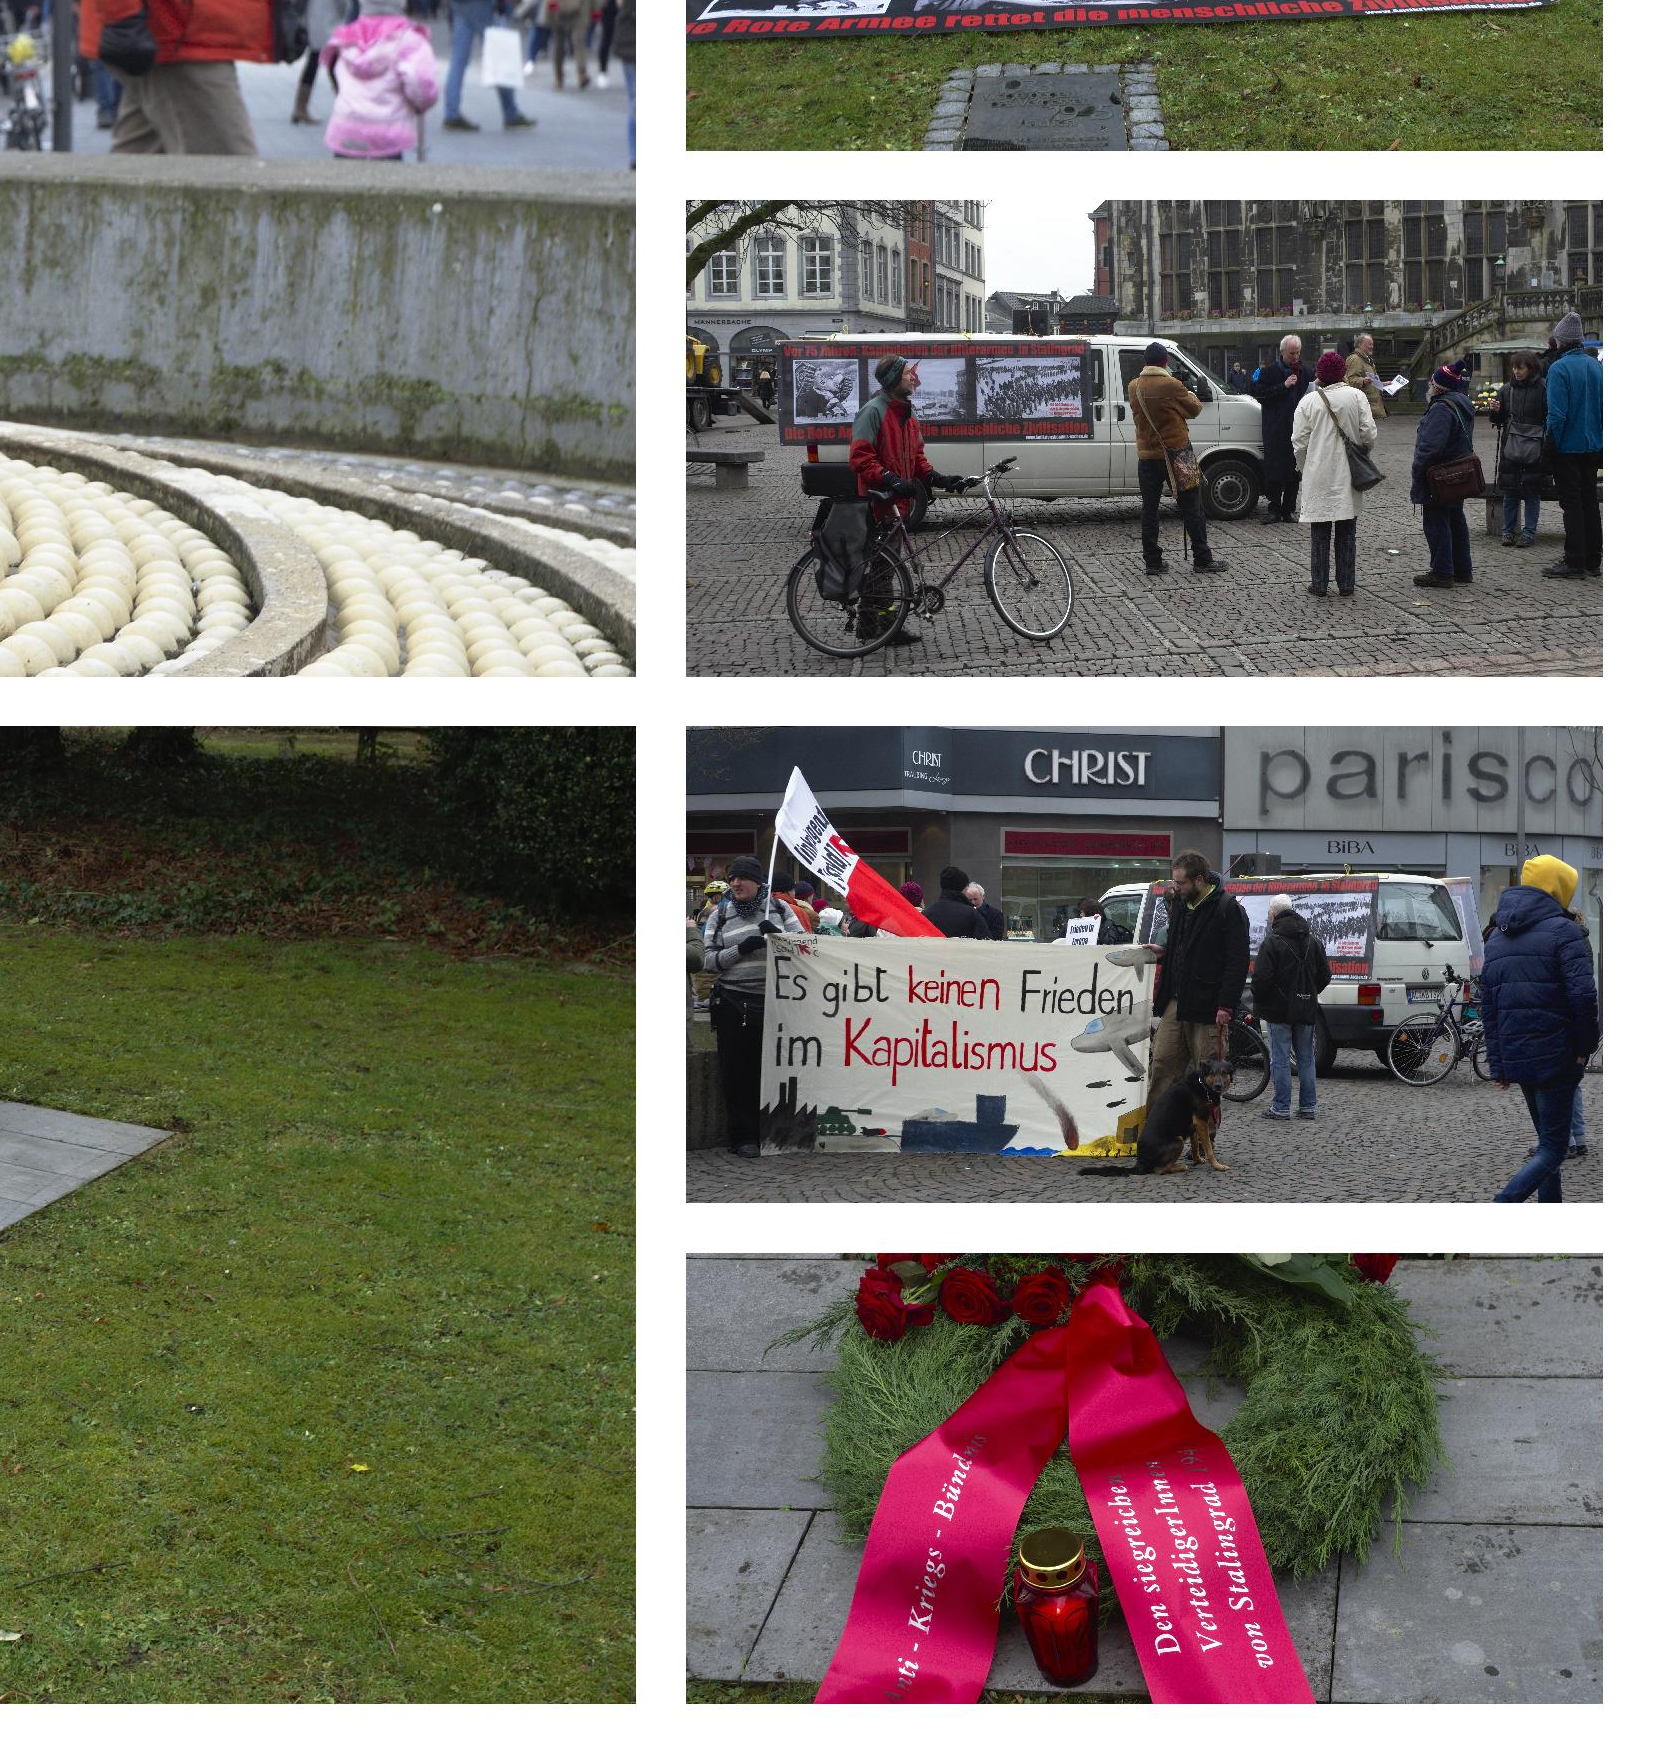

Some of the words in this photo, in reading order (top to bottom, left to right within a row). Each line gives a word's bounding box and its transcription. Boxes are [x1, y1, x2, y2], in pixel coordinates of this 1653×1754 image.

[723, 18, 812, 35] Rote
[815, 15, 937, 33] Armee
[944, 10, 1047, 29] rettet
[1062, 7, 1109, 23] die
[912, 750, 944, 768] CHRIST
[1024, 748, 1152, 786] CHRIST
[773, 955, 808, 1001] Es
[821, 963, 890, 1018] gibt
[907, 964, 1000, 1010] keinen
[1020, 963, 1134, 1015] Frieden
[775, 1023, 822, 1067] im
[843, 1017, 1058, 1087] Kapitalismus
[931, 1433, 989, 1522] Bündnis
[1107, 1473, 1162, 1596] siegreichen
[1189, 1480, 1255, 1612] Stalingrad
[906, 1546, 947, 1636] Kriegs
[1153, 1602, 1182, 1658] Den
[1243, 1621, 1275, 1670] von
